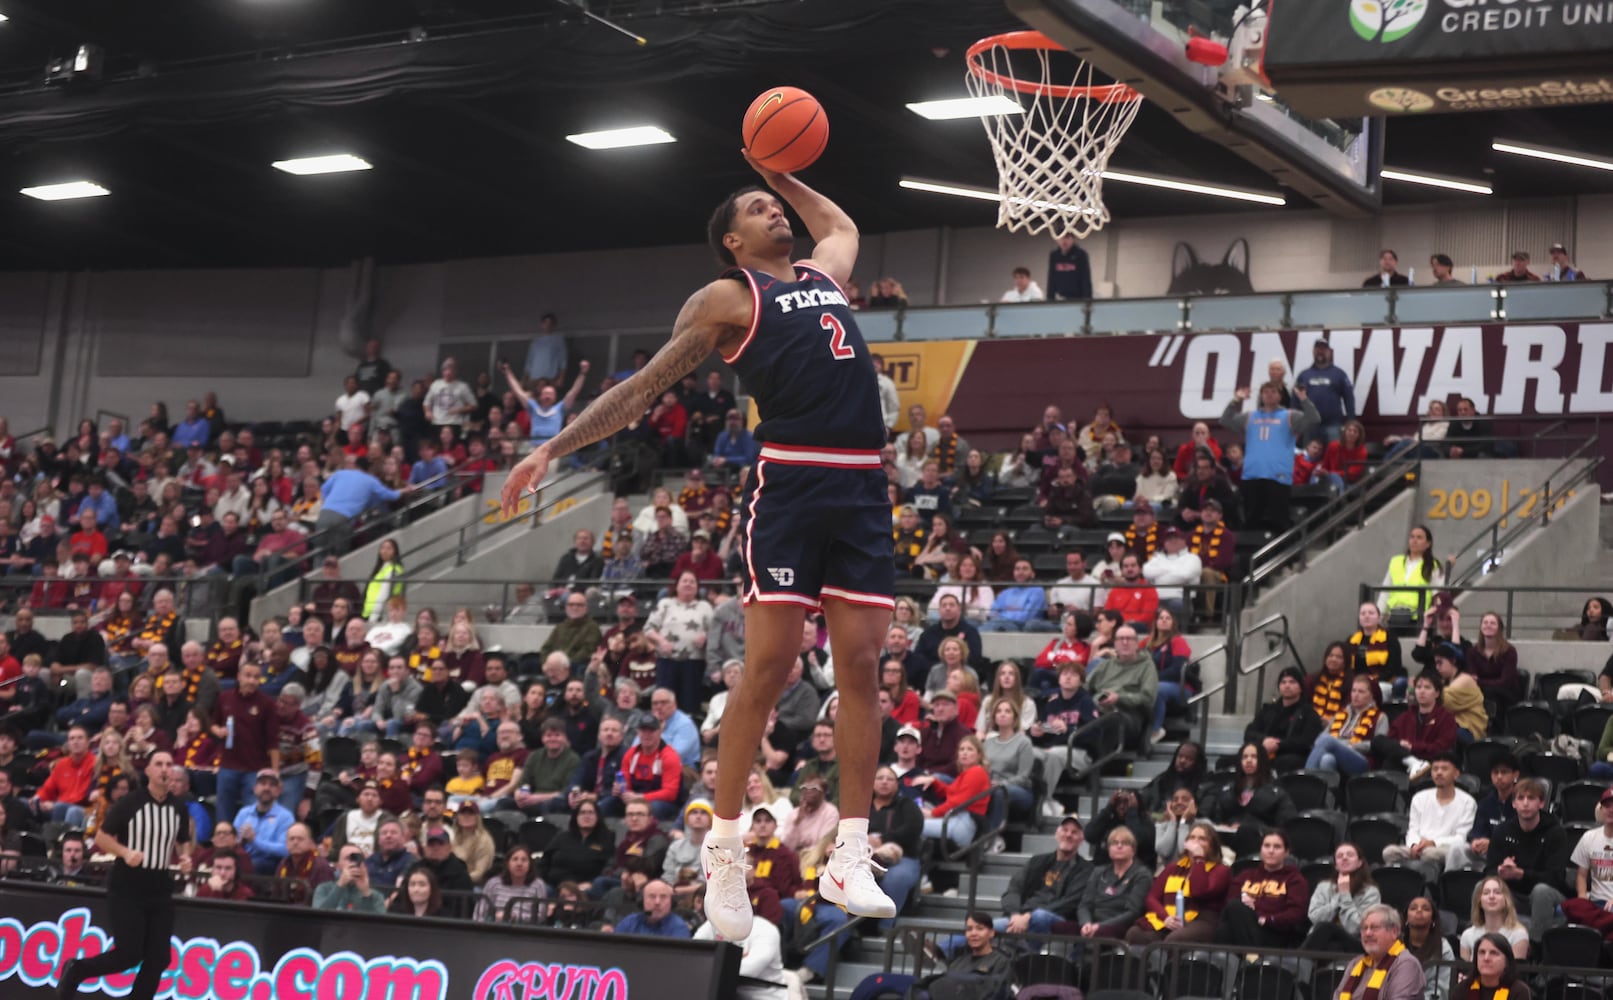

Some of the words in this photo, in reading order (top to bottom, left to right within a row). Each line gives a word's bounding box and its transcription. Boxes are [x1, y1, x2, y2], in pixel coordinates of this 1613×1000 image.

[1441, 6, 1552, 33] CREDIT
[820, 313, 855, 359] 2
[1427, 489, 1493, 520] 209
